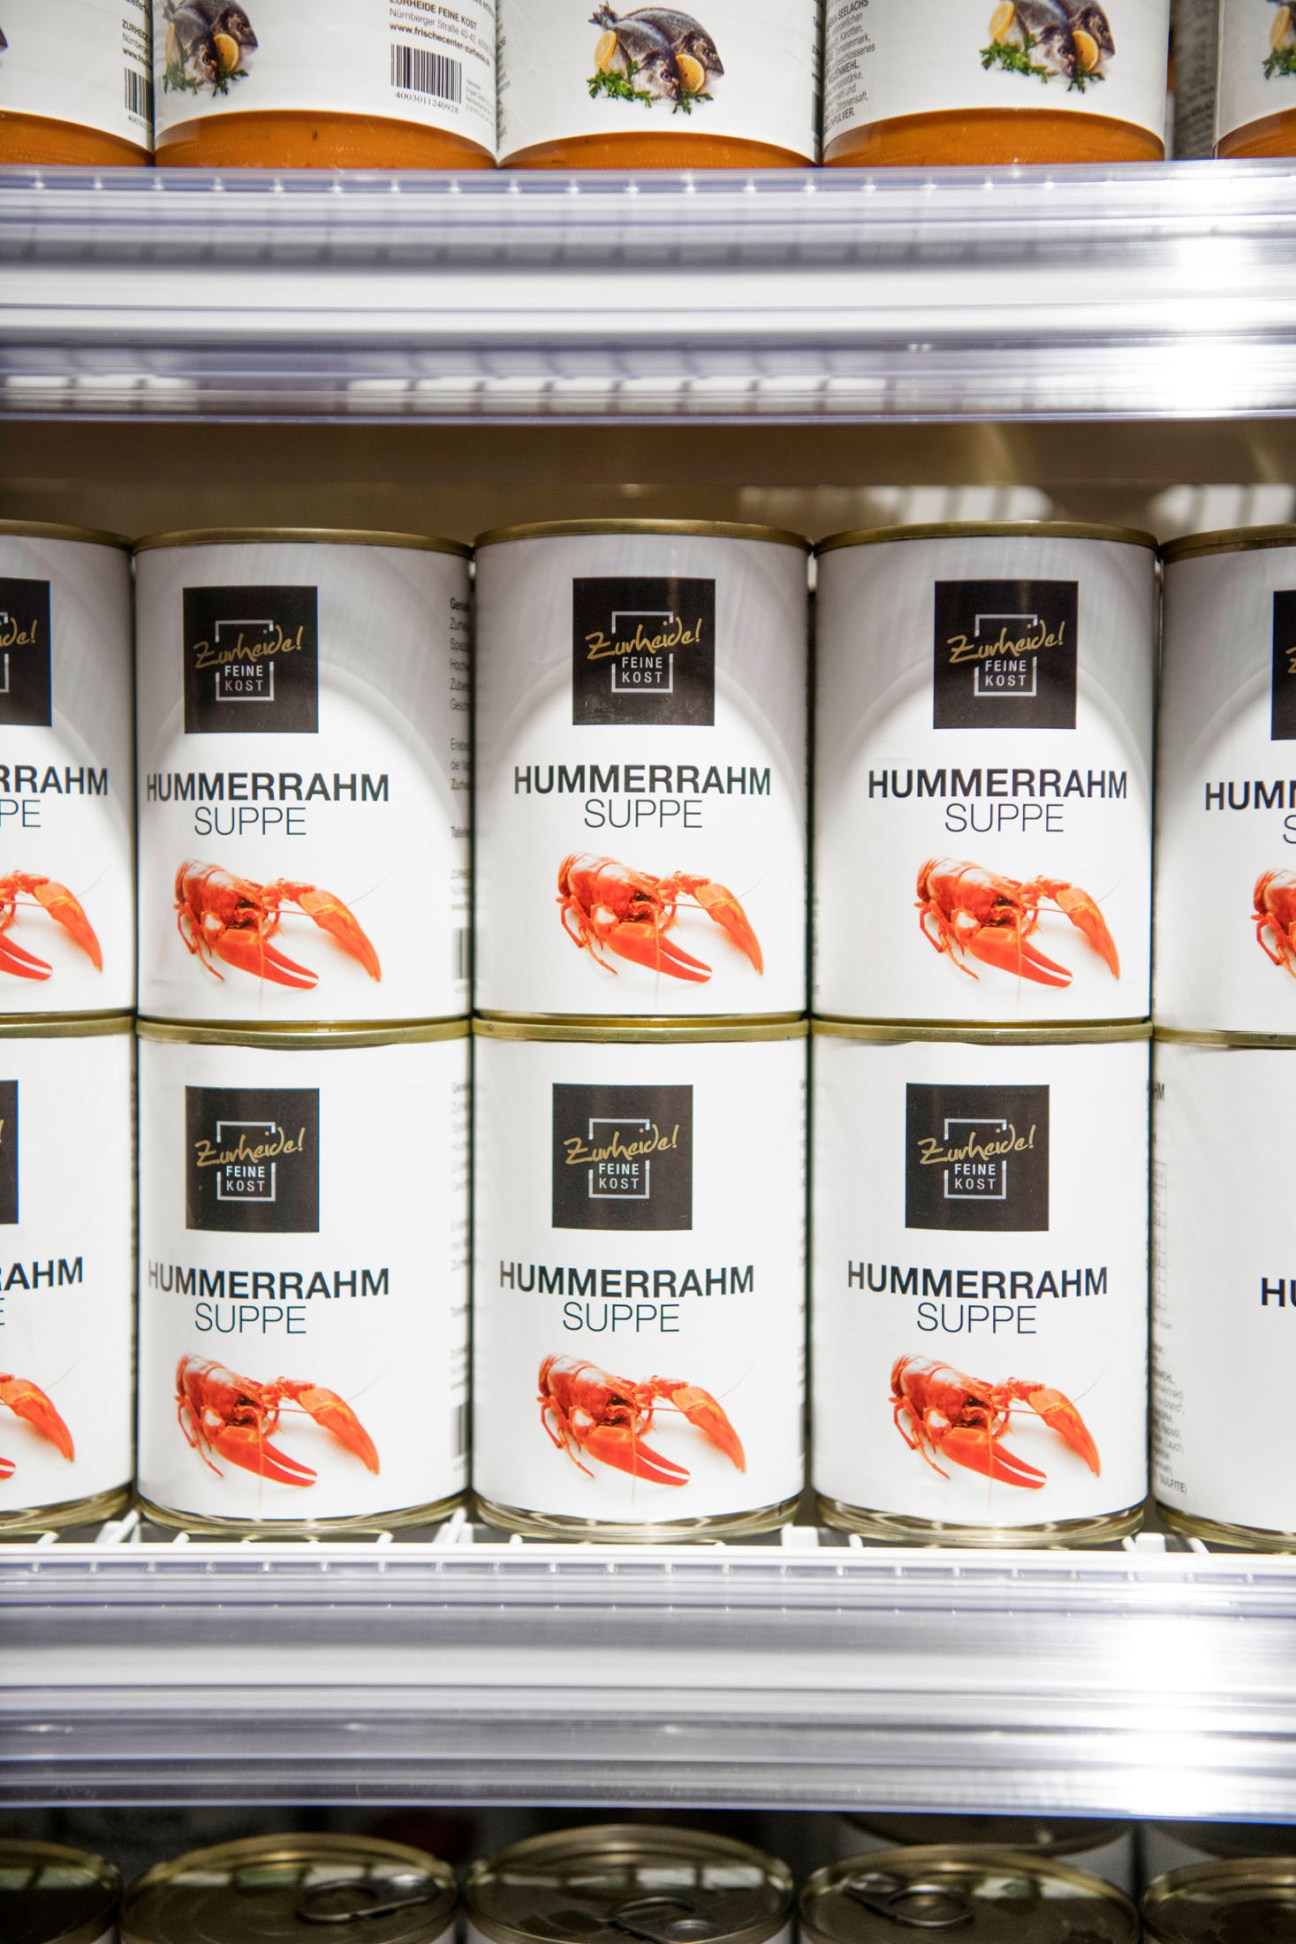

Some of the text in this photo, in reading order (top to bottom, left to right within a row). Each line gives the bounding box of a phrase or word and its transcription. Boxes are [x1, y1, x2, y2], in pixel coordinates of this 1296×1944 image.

[389, 7, 436, 27] Nürnberger
[438, 6, 460, 22] FEINE
[461, 15, 478, 31] KOST
[193, 625, 304, 669] Zurheide!
[584, 617, 703, 660] Zurheide!
[947, 620, 1066, 663] Zurheide!
[224, 665, 264, 678] FEINE
[621, 656, 664, 669] FEINE
[621, 671, 663, 683] KOST
[985, 660, 1027, 672] FEINE
[224, 679, 264, 692] KOST
[985, 674, 1027, 687] KOST
[146, 772, 389, 802] HUMMERRAHM
[514, 765, 771, 796] HUMMERRAHM
[868, 768, 1127, 799] HUMMERRAHM
[1205, 780, 1296, 811] HUM
[194, 805, 307, 836] SUPPE
[584, 798, 703, 828] SUPPE
[945, 803, 1064, 832] SUPPE
[194, 1126, 306, 1167] Zurheide!
[564, 1124, 680, 1165] Zurheide!
[917, 1124, 1037, 1165] Zurheide!
[226, 1165, 265, 1178] FEINE
[598, 1163, 640, 1175] FEINE
[598, 1178, 639, 1190] KOST
[954, 1163, 996, 1176] FEINE
[954, 1178, 996, 1190] KOST
[226, 1180, 265, 1192] KOST
[0, 1256, 83, 1292] AHM
[149, 1260, 389, 1299] HUMMERRAHM
[500, 1260, 754, 1298] HUMMERRAHM
[848, 1260, 1107, 1299] HUMMERRAHM
[195, 1302, 307, 1334] SUPPE
[563, 1301, 680, 1332] SUPPE
[917, 1302, 1037, 1334] SUPPE
